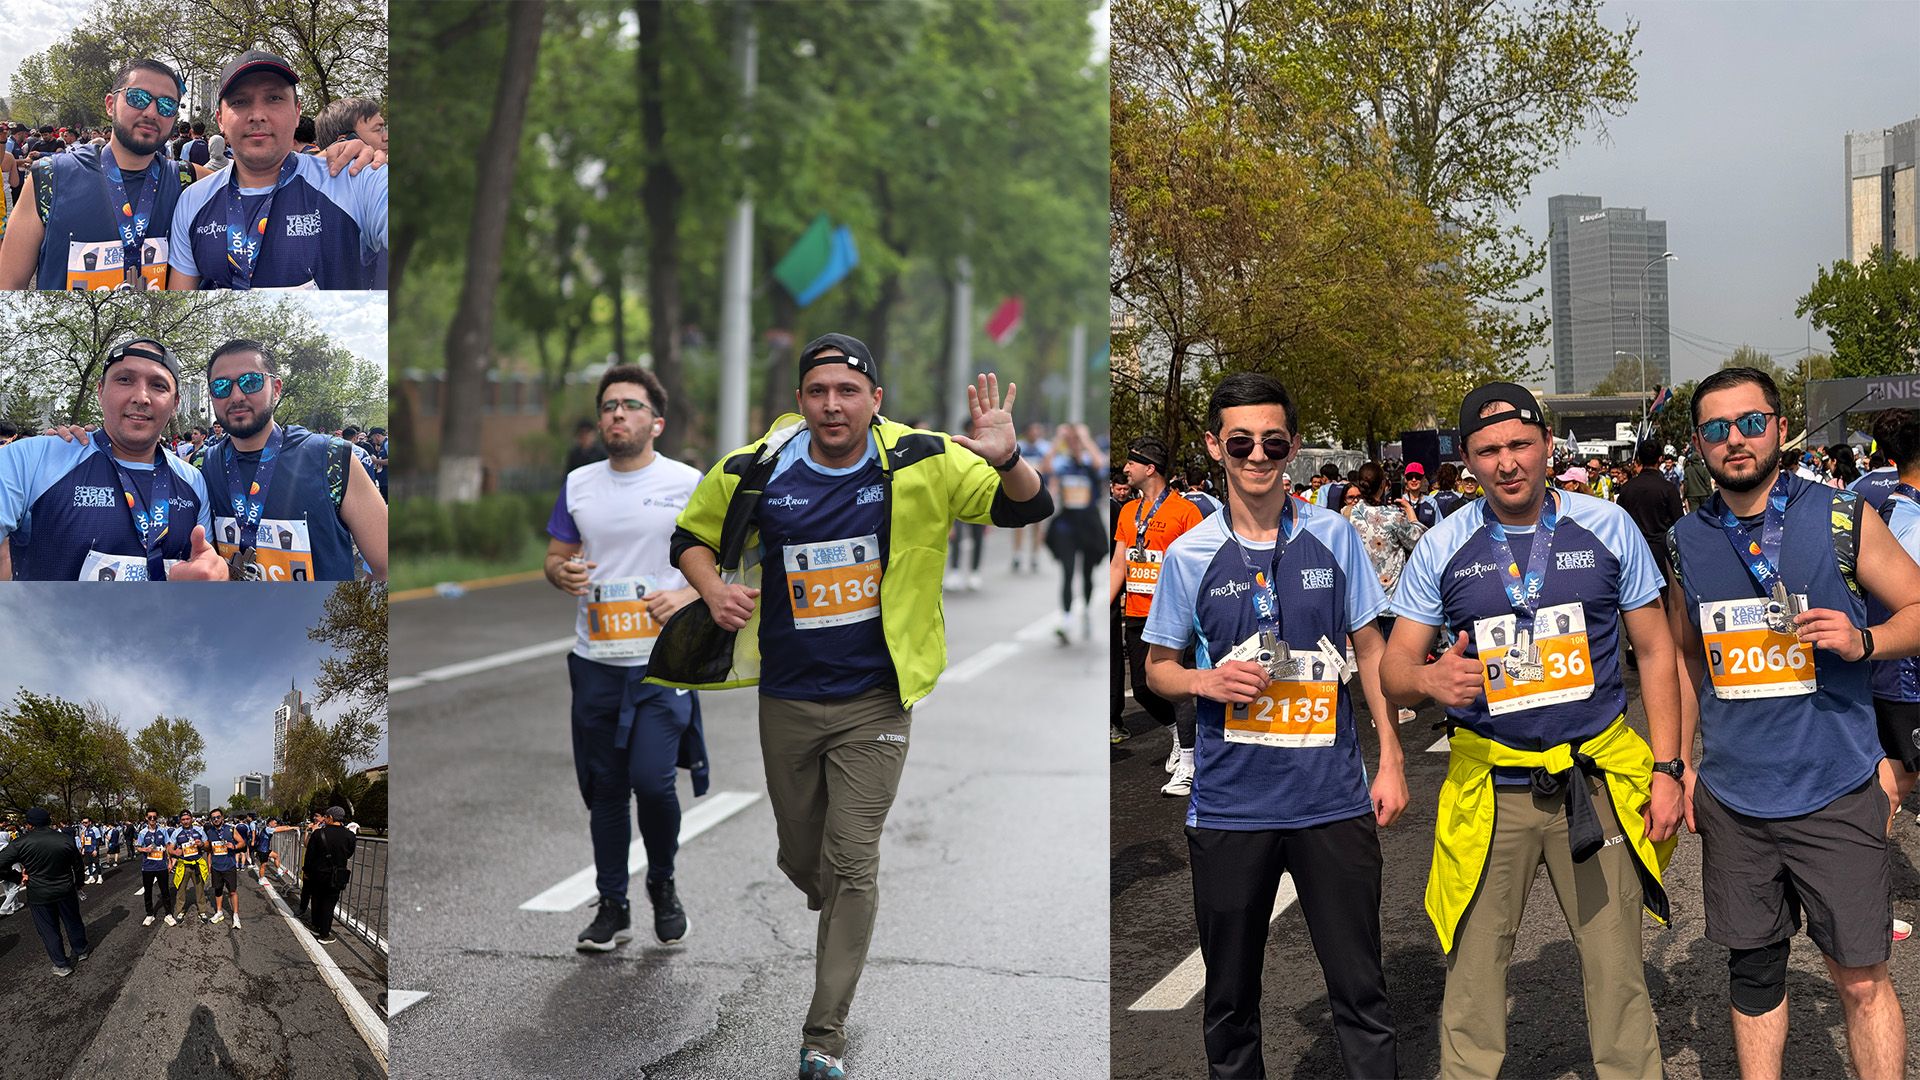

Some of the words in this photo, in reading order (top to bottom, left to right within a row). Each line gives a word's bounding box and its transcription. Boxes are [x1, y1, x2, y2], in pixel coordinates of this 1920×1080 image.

[122, 224, 135, 246] 10K
[215, 224, 228, 233] RU
[232, 231, 243, 255] 10K
[105, 247, 124, 256] TAS
[104, 255, 124, 264] KEN
[152, 265, 166, 274] 10K
[1866, 380, 1920, 401] FINIS
[791, 498, 809, 506] RUN
[1555, 550, 1589, 561] TASH
[865, 562, 879, 572] 10K
[1556, 559, 1588, 568] KENT
[1130, 567, 1158, 580] 2085
[1301, 569, 1329, 580] TASH
[1454, 569, 1472, 579] PRO
[1754, 561, 1771, 580] 10K
[793, 585, 804, 600] D
[811, 574, 879, 607] 2136
[1210, 587, 1227, 597] PRO
[1527, 577, 1540, 599] 10K
[1510, 585, 1524, 606] 10K
[1257, 594, 1272, 618] 10K
[1731, 606, 1764, 616] TASH
[602, 611, 653, 633] 11311
[1732, 614, 1762, 624] KENT
[1570, 635, 1586, 645] 10K
[1547, 649, 1586, 679] 36
[1710, 649, 1722, 666] D
[1728, 643, 1807, 675] 2066
[1487, 663, 1501, 681] D
[1321, 685, 1336, 693] 10K
[1255, 696, 1330, 723] 2135
